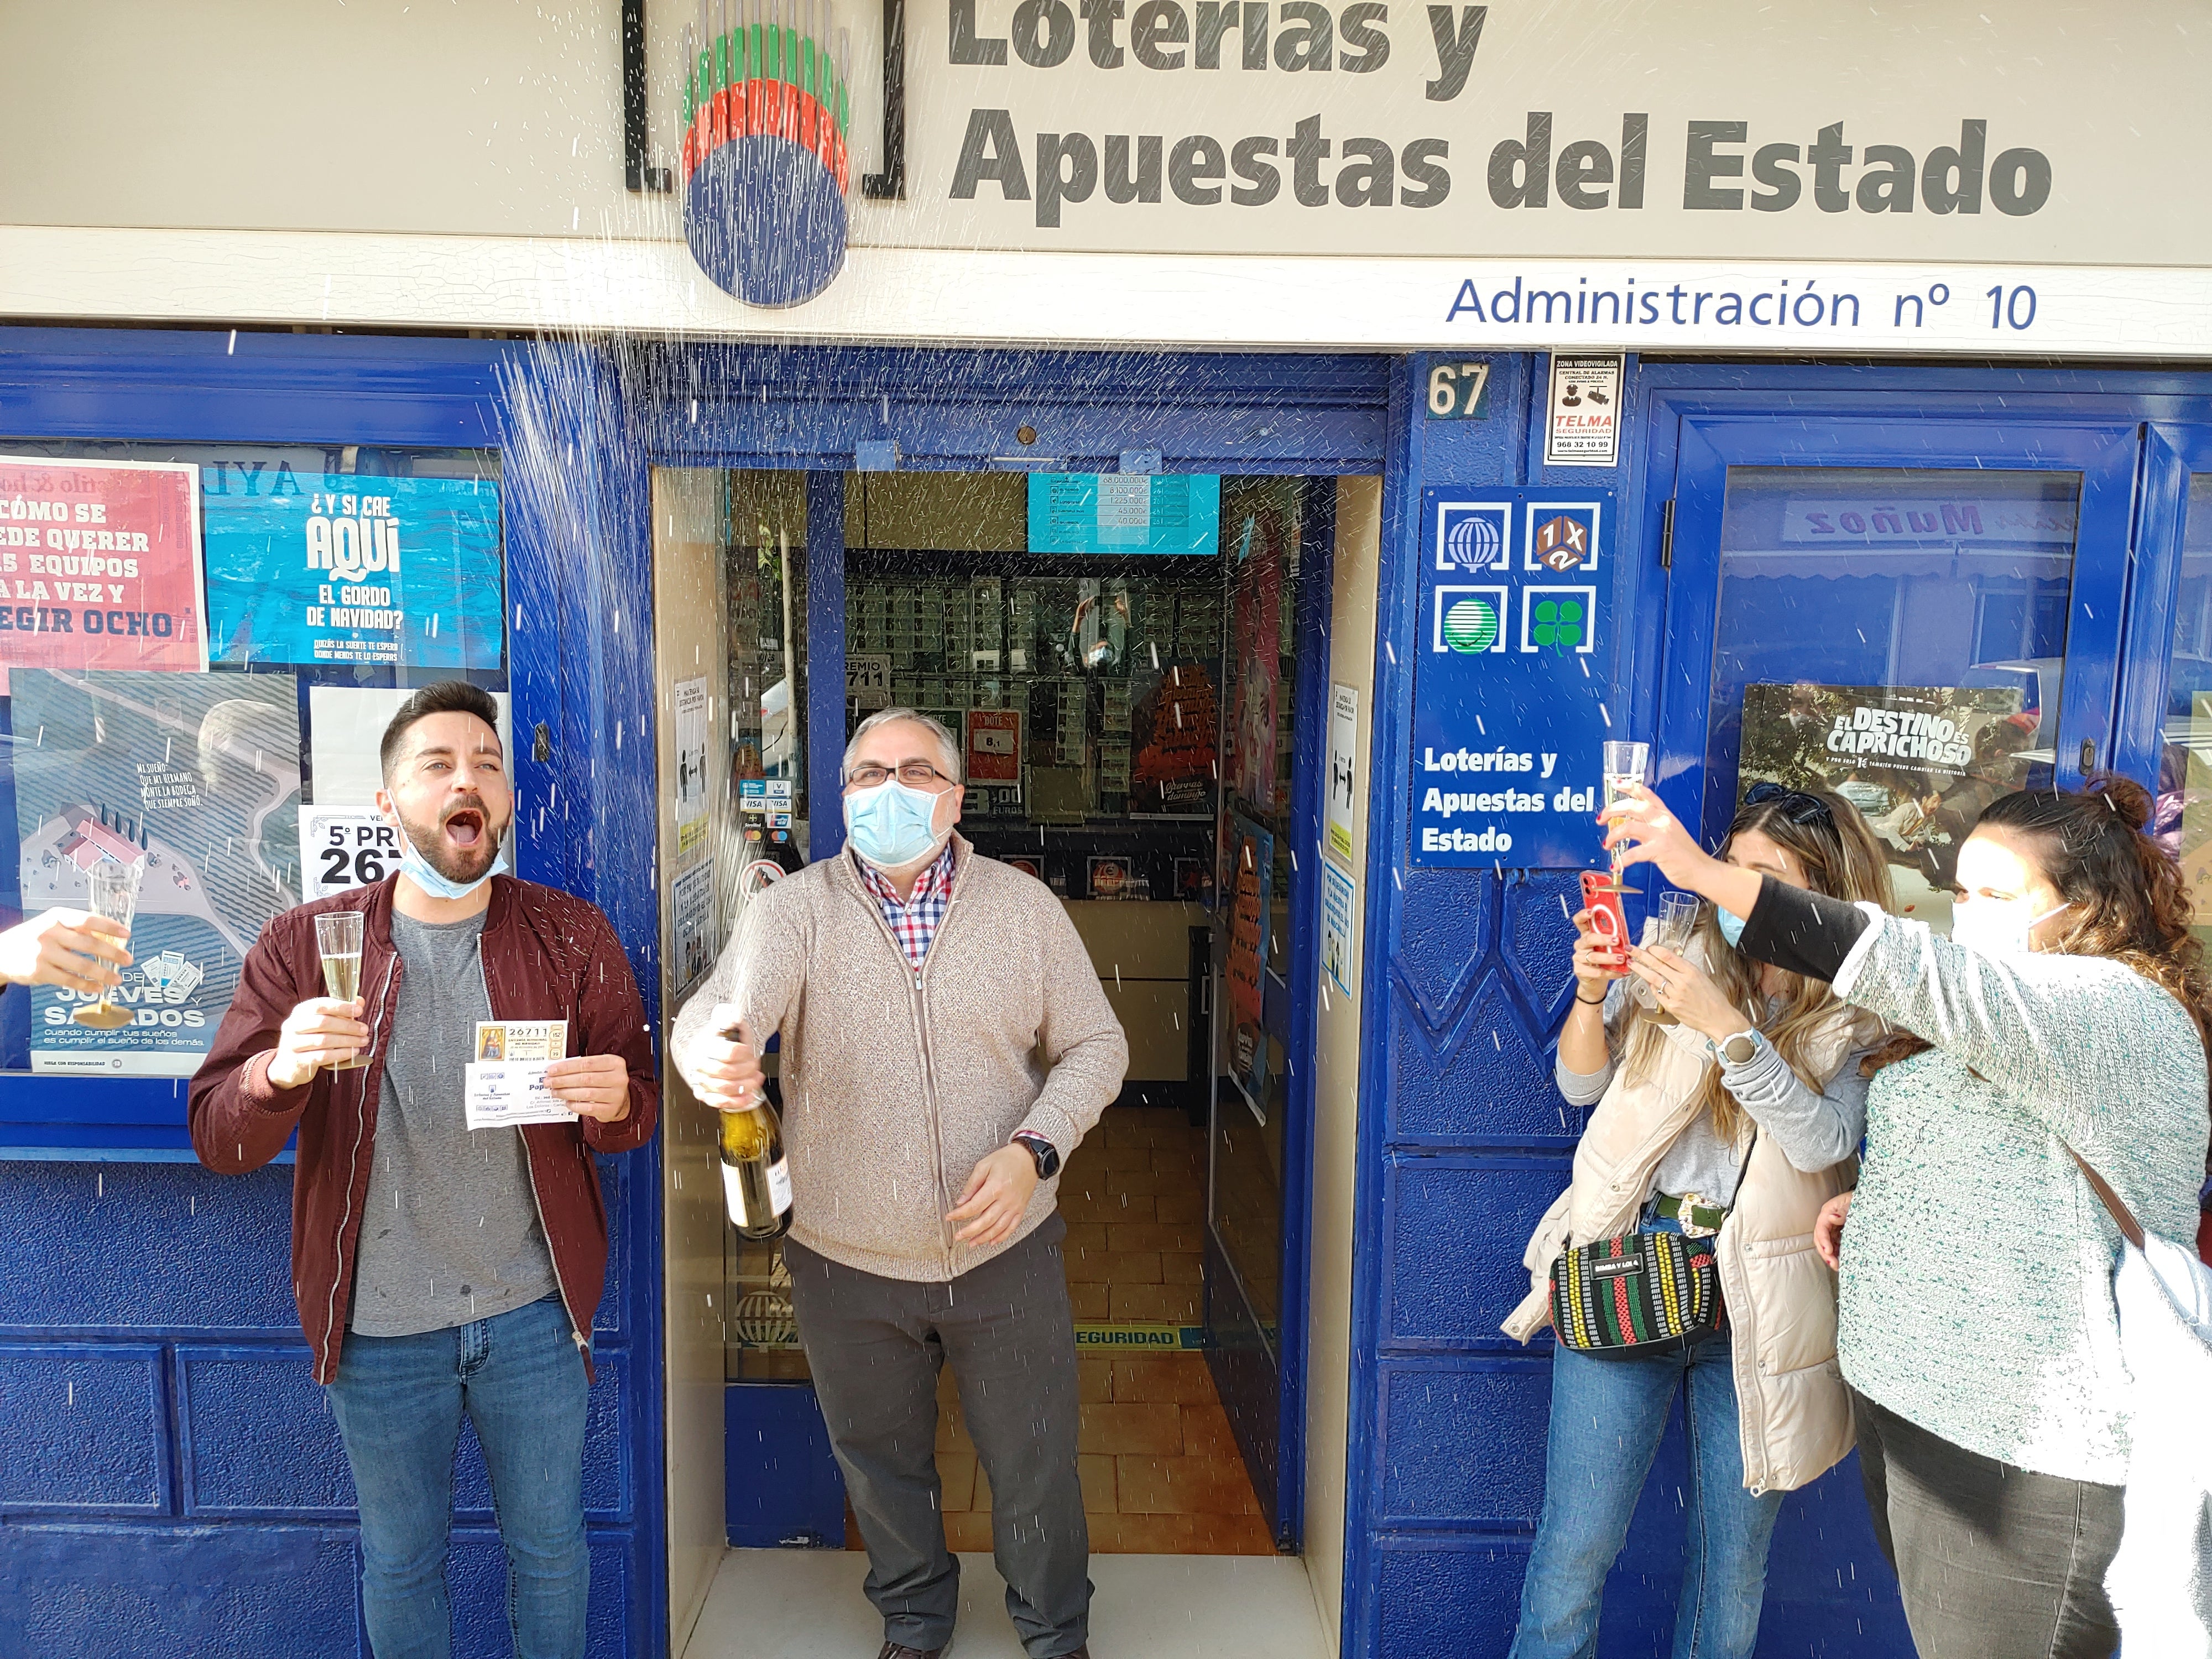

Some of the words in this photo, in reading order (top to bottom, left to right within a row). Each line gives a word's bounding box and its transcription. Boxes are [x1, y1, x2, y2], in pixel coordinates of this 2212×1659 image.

[1426, 4, 1488, 101] y
[948, 108, 1451, 227] Apuestas
[1487, 112, 1649, 210] del
[1683, 119, 2052, 216] Estado
[1446, 276, 1860, 326] Administración
[1986, 285, 2037, 330] 10
[1429, 363, 1489, 415] 67
[1556, 415, 1612, 427] TELMA
[75, 503, 106, 523] SE
[342, 495, 357, 515] SI
[363, 496, 390, 517] CAE
[47, 529, 149, 552] QUERER
[306, 516, 400, 582] AQUÍ
[29, 554, 138, 578] EQUIPOS
[15, 580, 50, 600] LA
[54, 581, 103, 602] VEZ
[108, 584, 124, 603] Y
[319, 585, 335, 604] EL
[341, 585, 390, 607] GORDO
[84, 609, 173, 637] OCHO
[307, 606, 325, 627] DE
[331, 607, 404, 630] NAVIDAD?
[314, 638, 335, 649] QUIZÁS
[336, 640, 344, 649] LA
[346, 641, 366, 650] SUERTE
[368, 641, 375, 650] TE
[377, 641, 398, 651] ESPERA
[314, 650, 332, 658] DONDE
[355, 651, 362, 660] TE
[363, 652, 371, 660] LO
[372, 653, 398, 661] ESPERAS
[984, 716, 1003, 726] BOTE
[1834, 715, 1853, 731] EL
[1853, 707, 1955, 743] DESTINO
[1953, 732, 1969, 744] ES
[1827, 729, 1972, 766] CAPRICHOSO
[137, 763, 146, 773] MI
[1425, 746, 1533, 771] Loterías
[1541, 753, 1557, 778] y
[1857, 757, 1869, 769] 1€
[139, 775, 154, 786] QUE
[154, 775, 163, 784] MI
[163, 773, 192, 784] HERMANO
[140, 786, 161, 798] MONTE
[162, 786, 170, 796] LA
[171, 785, 196, 796] BODEGA
[1422, 787, 1545, 817] Apuestas
[1553, 786, 1595, 812] del
[145, 799, 156, 811] QUE
[158, 797, 183, 808] SIEMPRE
[1422, 826, 1512, 852] Estado
[122, 972, 144, 983] DE
[190, 997, 203, 1006] Y
[59, 1037, 95, 1046] cumplir
[85, 1029, 118, 1038] cumplir
[1595, 1264, 1616, 1272] BIMBA
[1076, 1331, 1173, 1344] EGURIDAD
